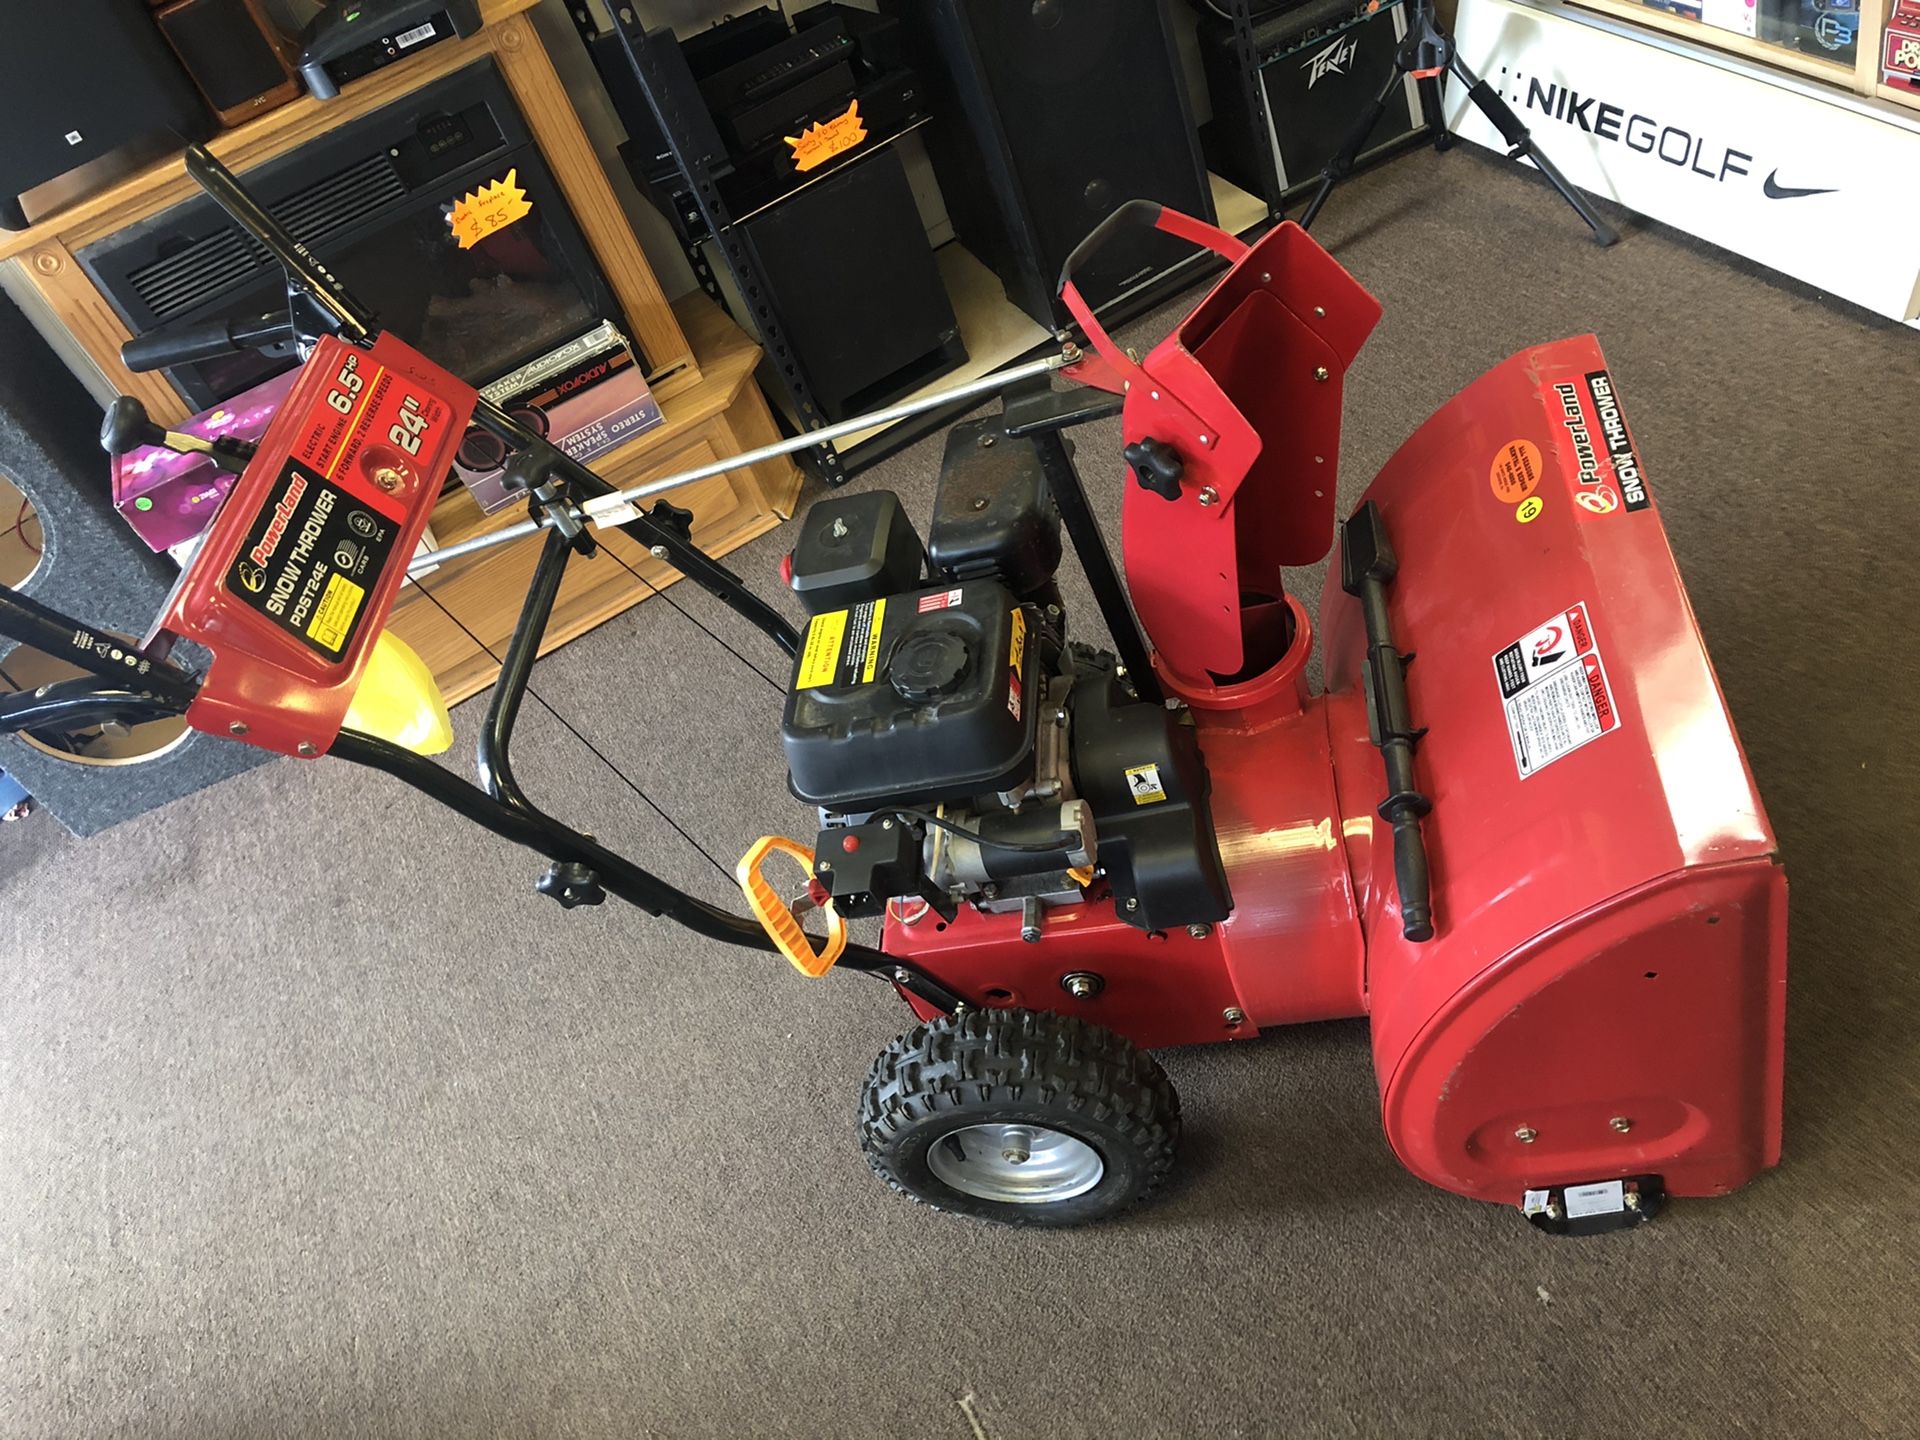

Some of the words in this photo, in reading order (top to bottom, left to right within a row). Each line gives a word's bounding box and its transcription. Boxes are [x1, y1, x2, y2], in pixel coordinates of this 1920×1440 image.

[1300, 34, 1359, 90] PEAVEY
[1894, 49, 1920, 69] PO
[253, 95, 267, 107] JVC
[525, 342, 582, 376] AUDIOVOX
[376, 373, 393, 402] SPEEDS
[487, 382, 519, 399] YSTEM
[557, 362, 610, 394] AUDIOVOX
[363, 399, 382, 433] REVERSE
[611, 409, 646, 434] STEREO
[1591, 375, 1628, 450] THROWER
[302, 423, 326, 460] ELECTRIC
[316, 441, 332, 469] START
[329, 417, 348, 446] ENGINE
[361, 429, 367, 439] 2
[565, 430, 608, 457] SPEAKER
[566, 422, 604, 445] SYSTEM
[336, 472, 344, 481] 6
[1614, 452, 1646, 504] SNOW
[1521, 500, 1537, 519] 19
[375, 528, 387, 542] EPA
[266, 564, 302, 616] SNOW
[290, 488, 338, 565] THROWER
[357, 554, 370, 575] CARB
[290, 560, 328, 628] PDST24E
[318, 589, 334, 615] CAUTION
[1573, 619, 1589, 648] DANGER
[867, 633, 879, 670] WARNING
[1589, 674, 1611, 719] DANGER
